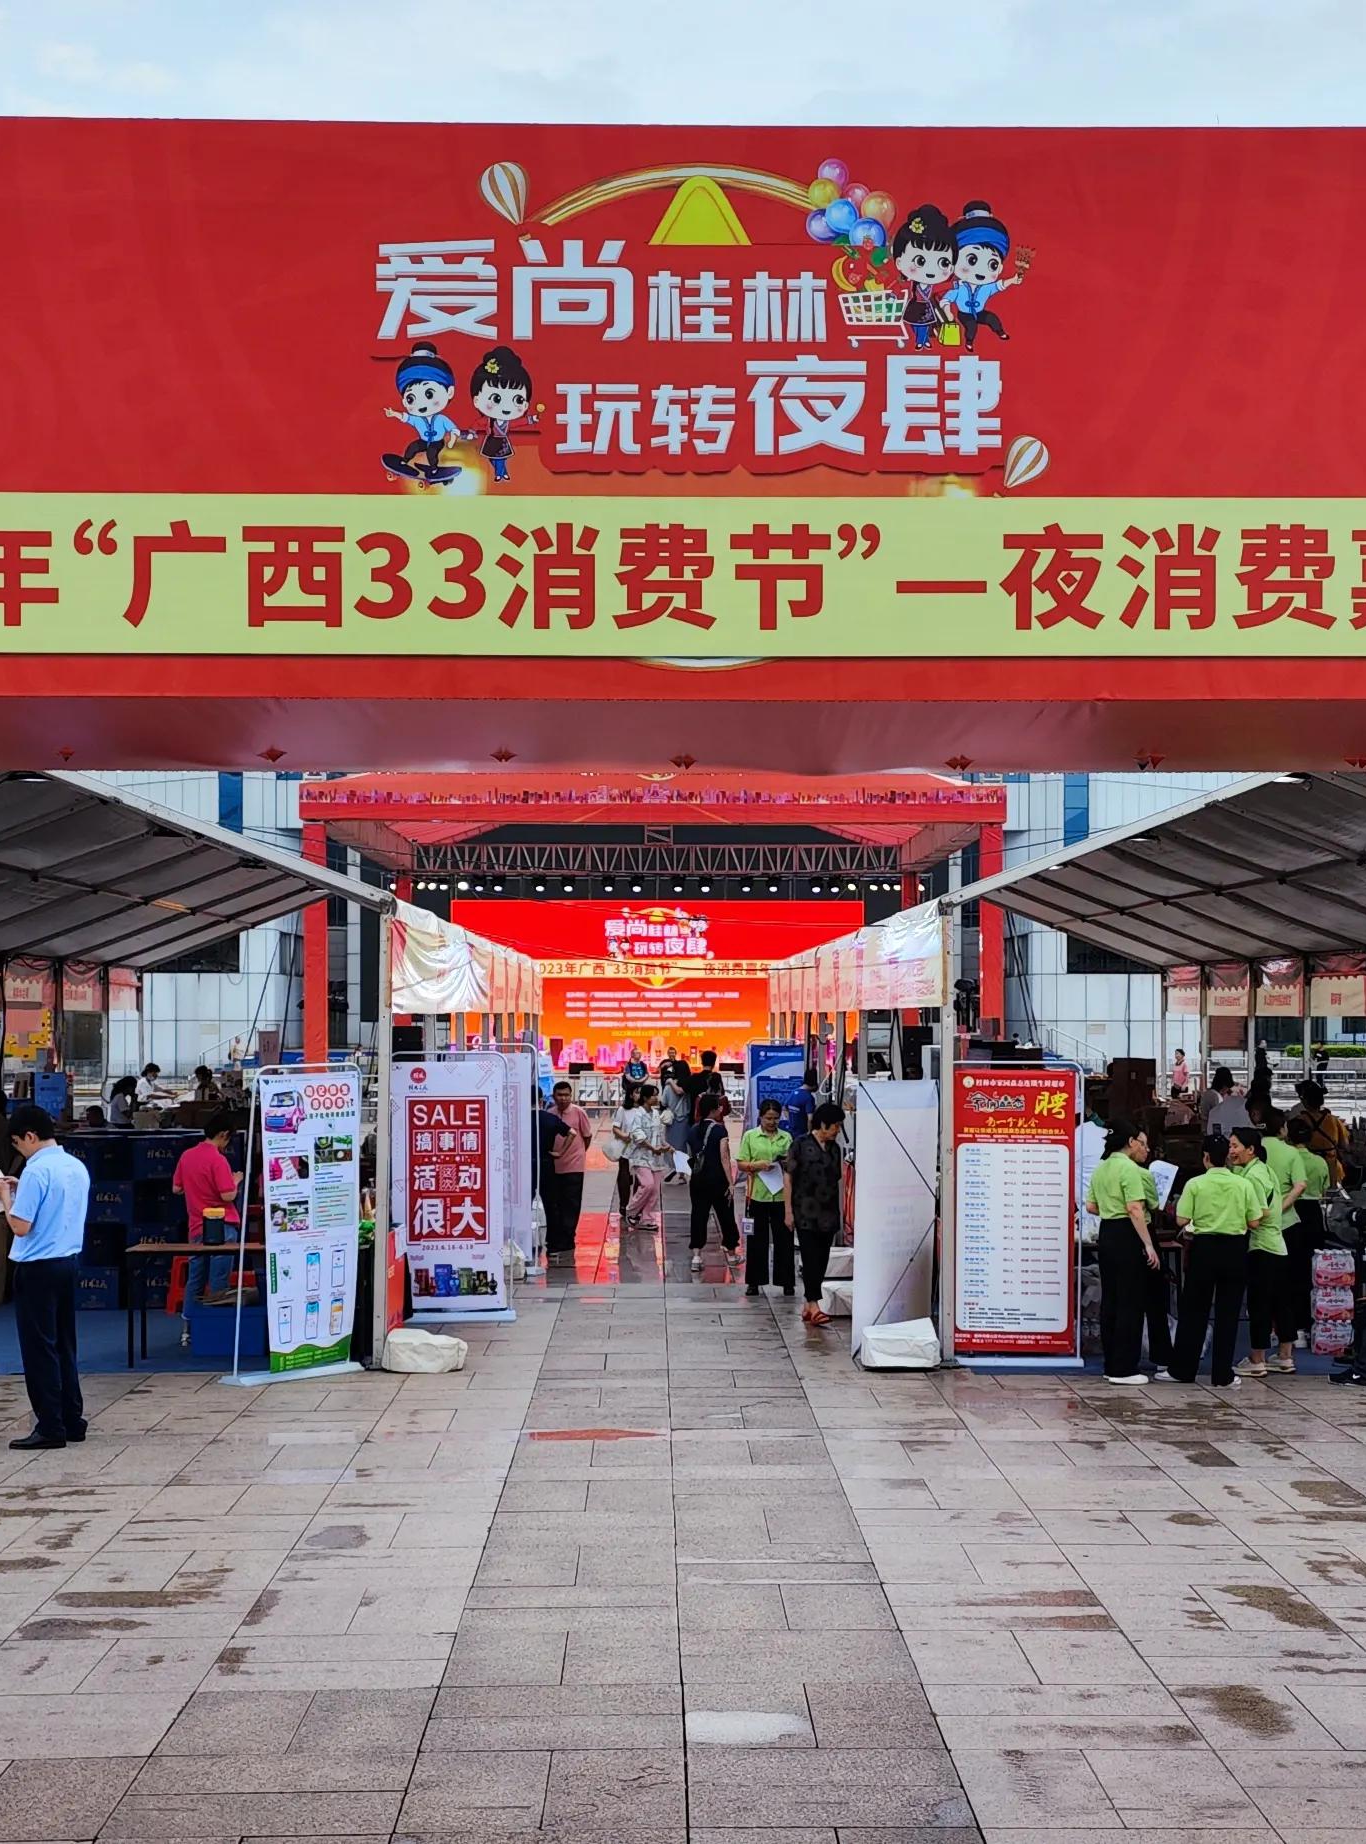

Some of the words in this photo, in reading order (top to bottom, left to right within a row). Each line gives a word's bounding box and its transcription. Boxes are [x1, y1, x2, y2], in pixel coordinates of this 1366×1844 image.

[374, 237, 828, 343] 爱尚桂林
[555, 354, 1005, 457] 玩转夜肆
[412, 1103, 482, 1126] SALE
[1034, 1090, 1069, 1119] 聘
[415, 1131, 479, 1152] 搞事情
[413, 1196, 485, 1237] 很大
